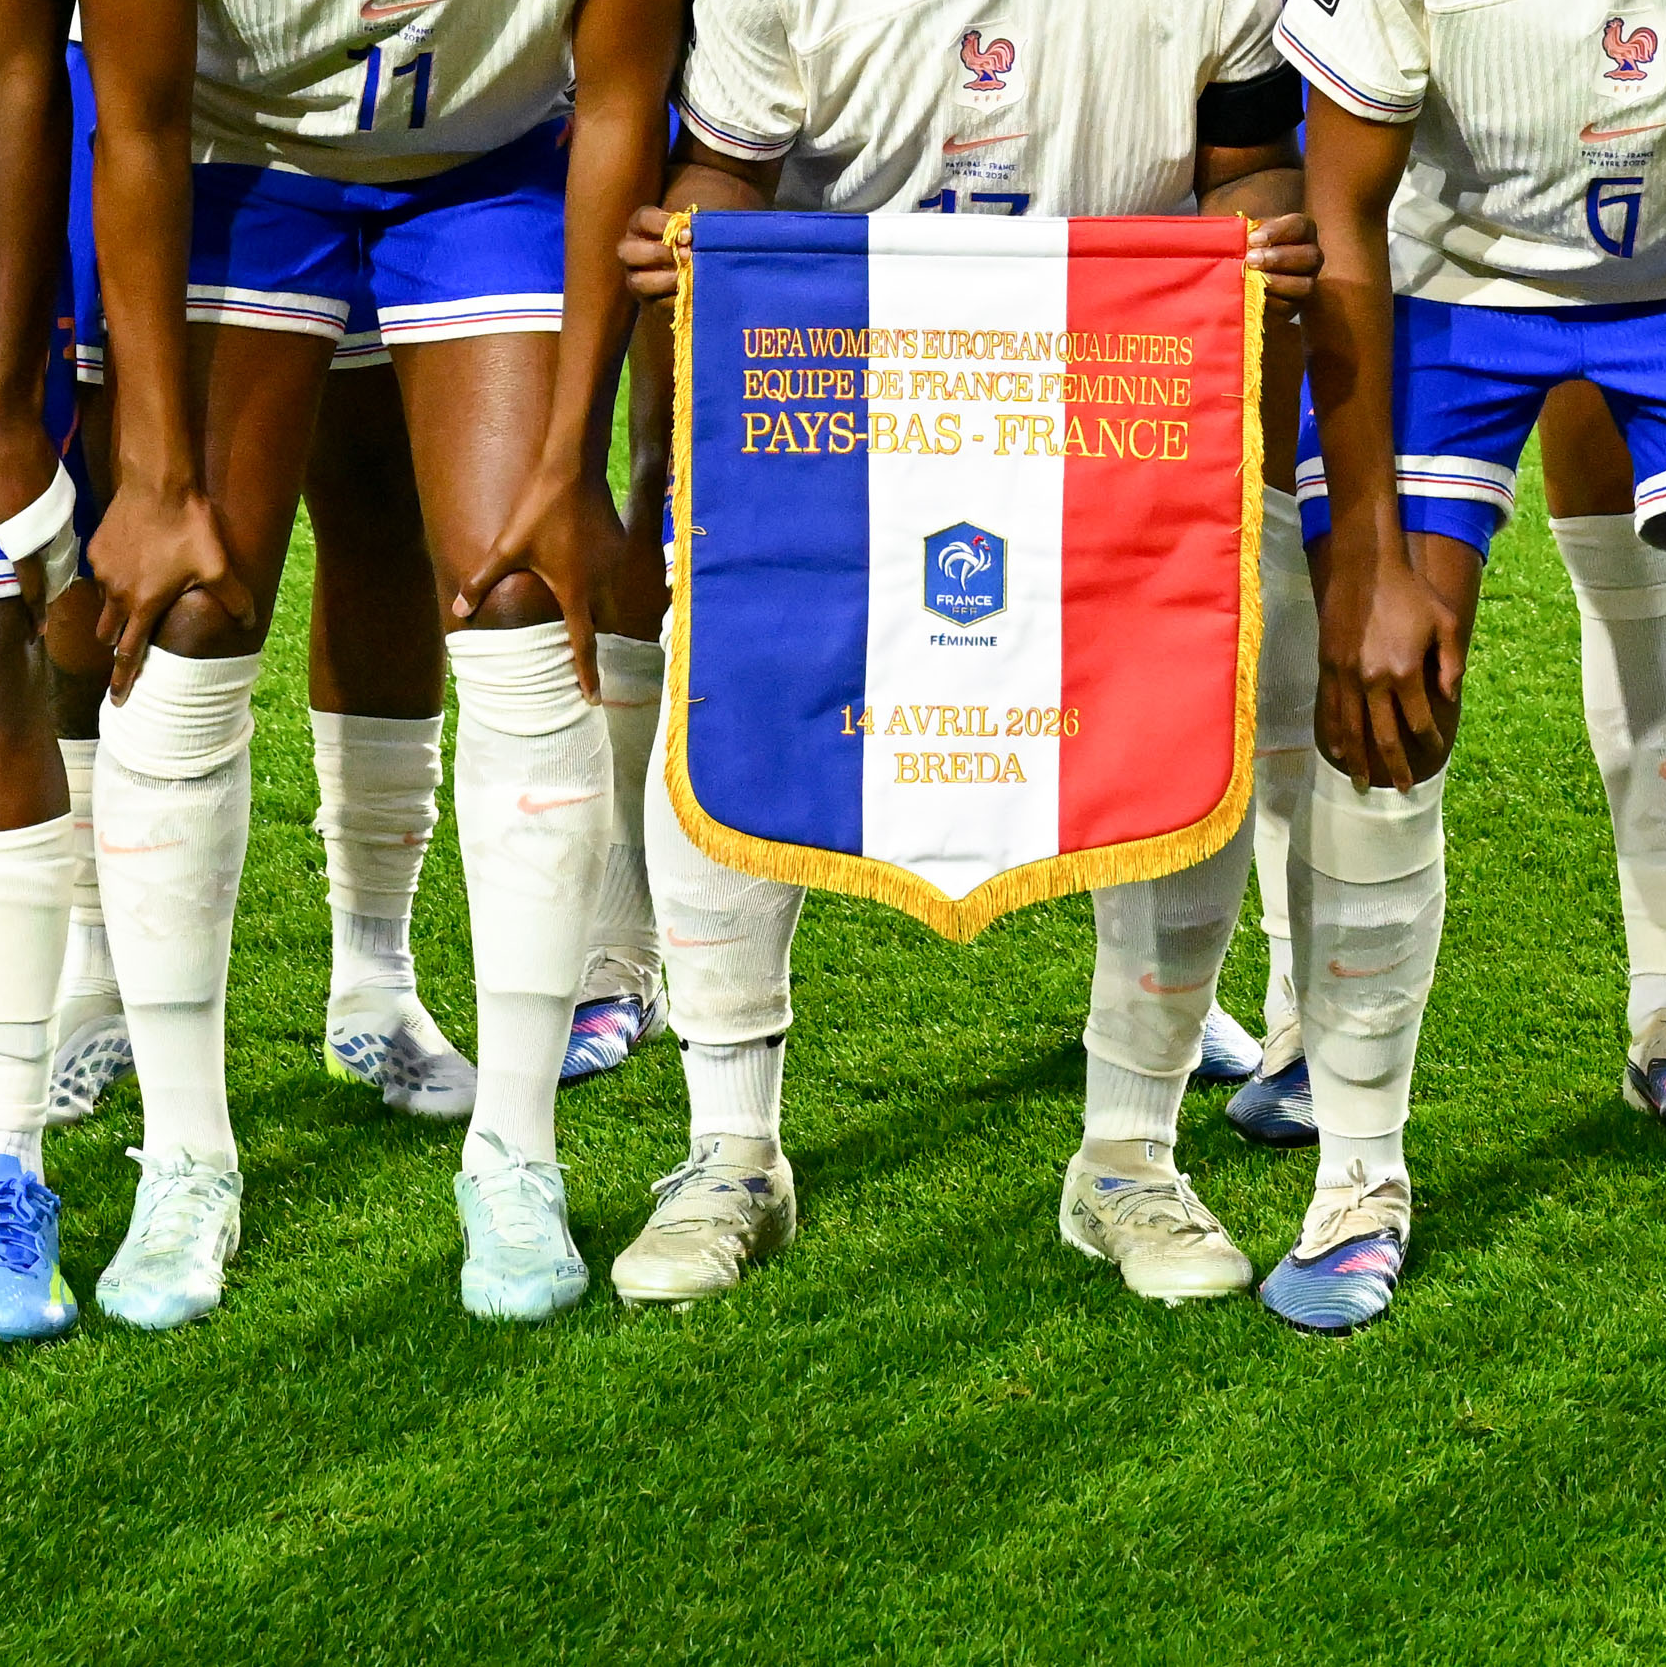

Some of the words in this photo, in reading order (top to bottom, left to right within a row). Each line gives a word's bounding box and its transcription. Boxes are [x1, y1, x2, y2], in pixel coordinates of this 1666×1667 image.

[347, 44, 433, 131] 11
[1586, 177, 1644, 259] 6
[742, 327, 806, 359] UEFA
[806, 328, 918, 360] WOMEN'S
[922, 330, 1053, 361] EUROPEAN
[1054, 332, 1194, 367] QUALIFIERS
[742, 370, 854, 402] EQUIPE
[861, 370, 905, 400] DE
[909, 370, 1034, 402] FRANCE
[1039, 372, 1192, 407] FEMININE
[742, 411, 963, 455] PAYS-BAS
[994, 415, 1190, 461] FRANCE
[936, 594, 993, 606] FRANCE
[952, 607, 978, 615] FFF
[930, 633, 998, 647] FÉMININE
[840, 704, 875, 737] 14
[886, 705, 999, 738] AVRIL
[1005, 706, 1081, 739] 2026
[894, 752, 1028, 785] BREDA
